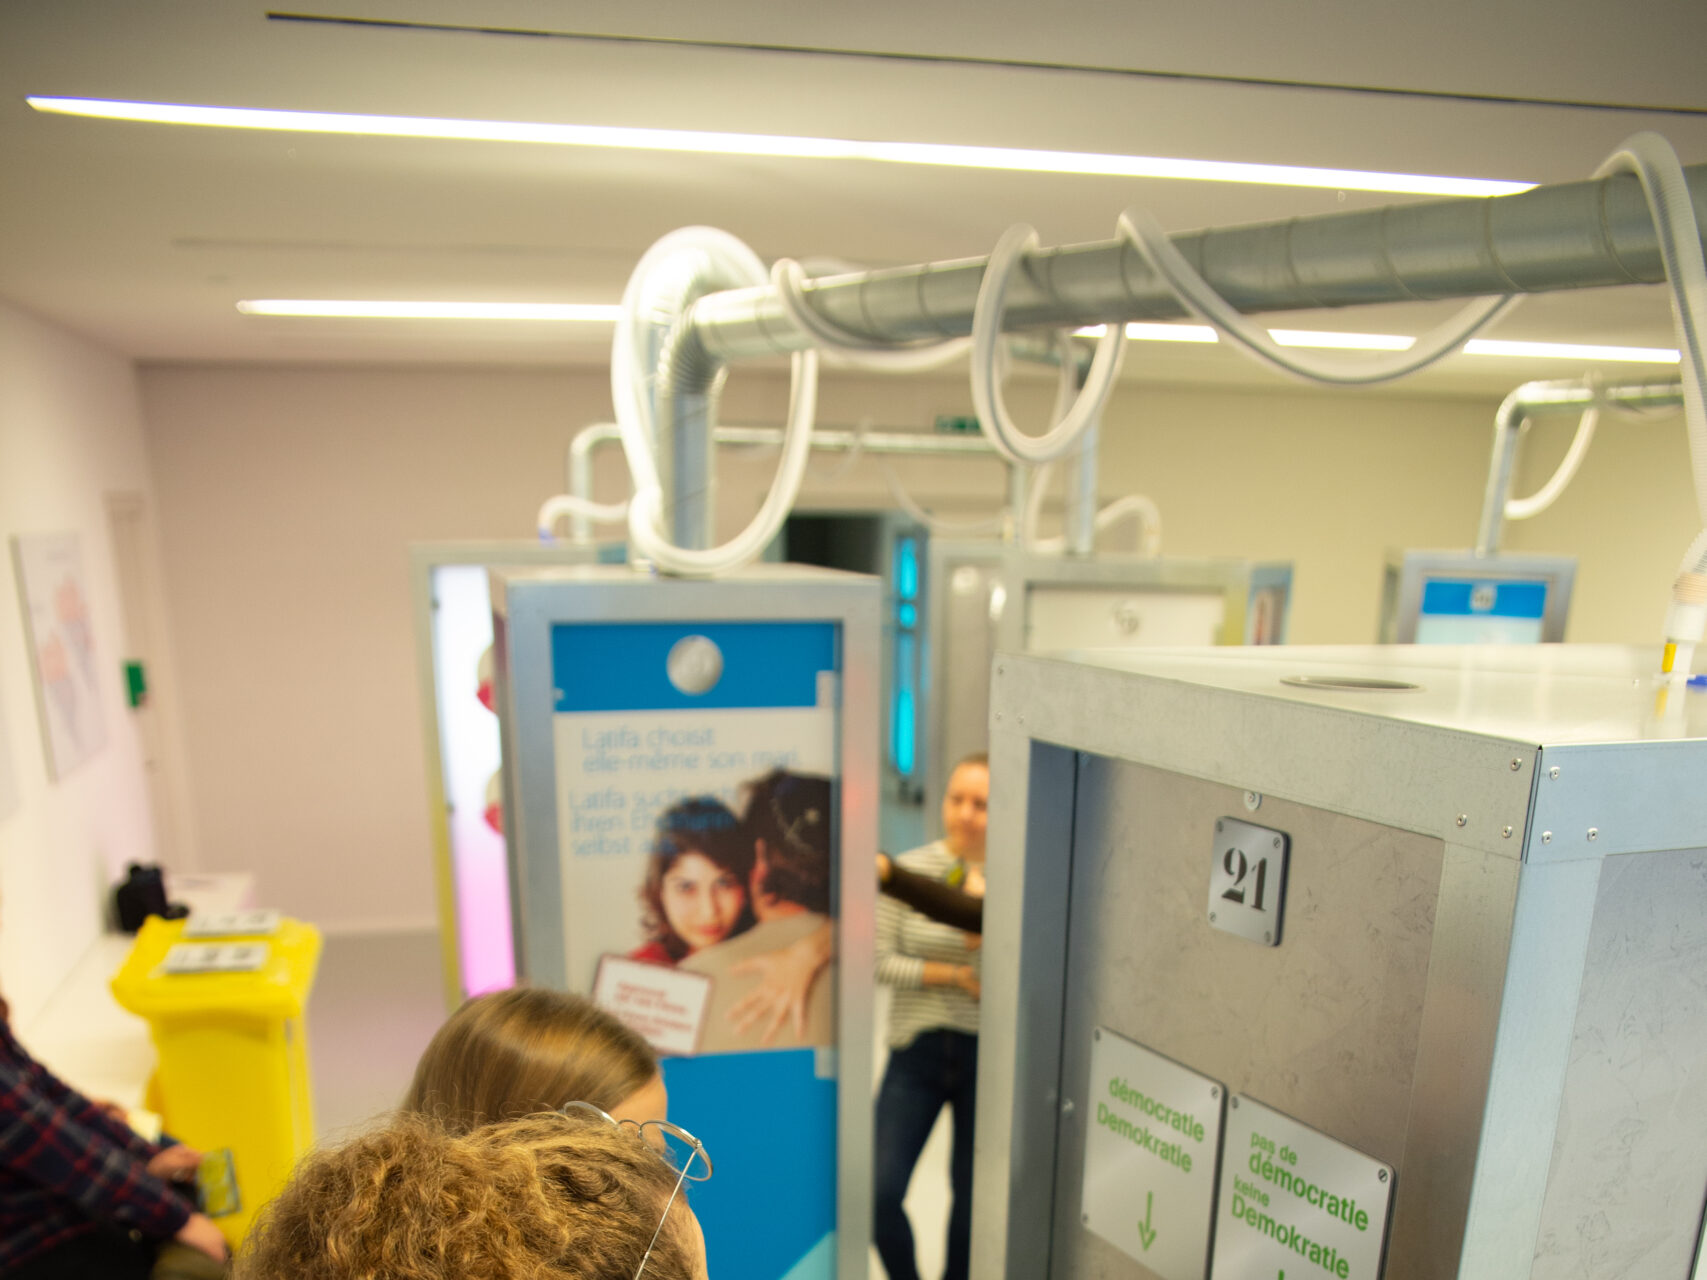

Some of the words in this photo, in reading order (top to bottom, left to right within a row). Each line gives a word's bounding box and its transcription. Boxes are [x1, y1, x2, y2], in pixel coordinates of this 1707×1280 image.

[1221, 847, 1267, 912] 21
[1097, 1101, 1192, 1173] Demokratie
[1108, 1076, 1205, 1143] démocratie
[1250, 1131, 1276, 1154] pas
[1279, 1145, 1298, 1166] de
[1233, 1173, 1270, 1207] keine
[1248, 1151, 1369, 1231] démocratie
[1231, 1192, 1350, 1280] Demokratie
